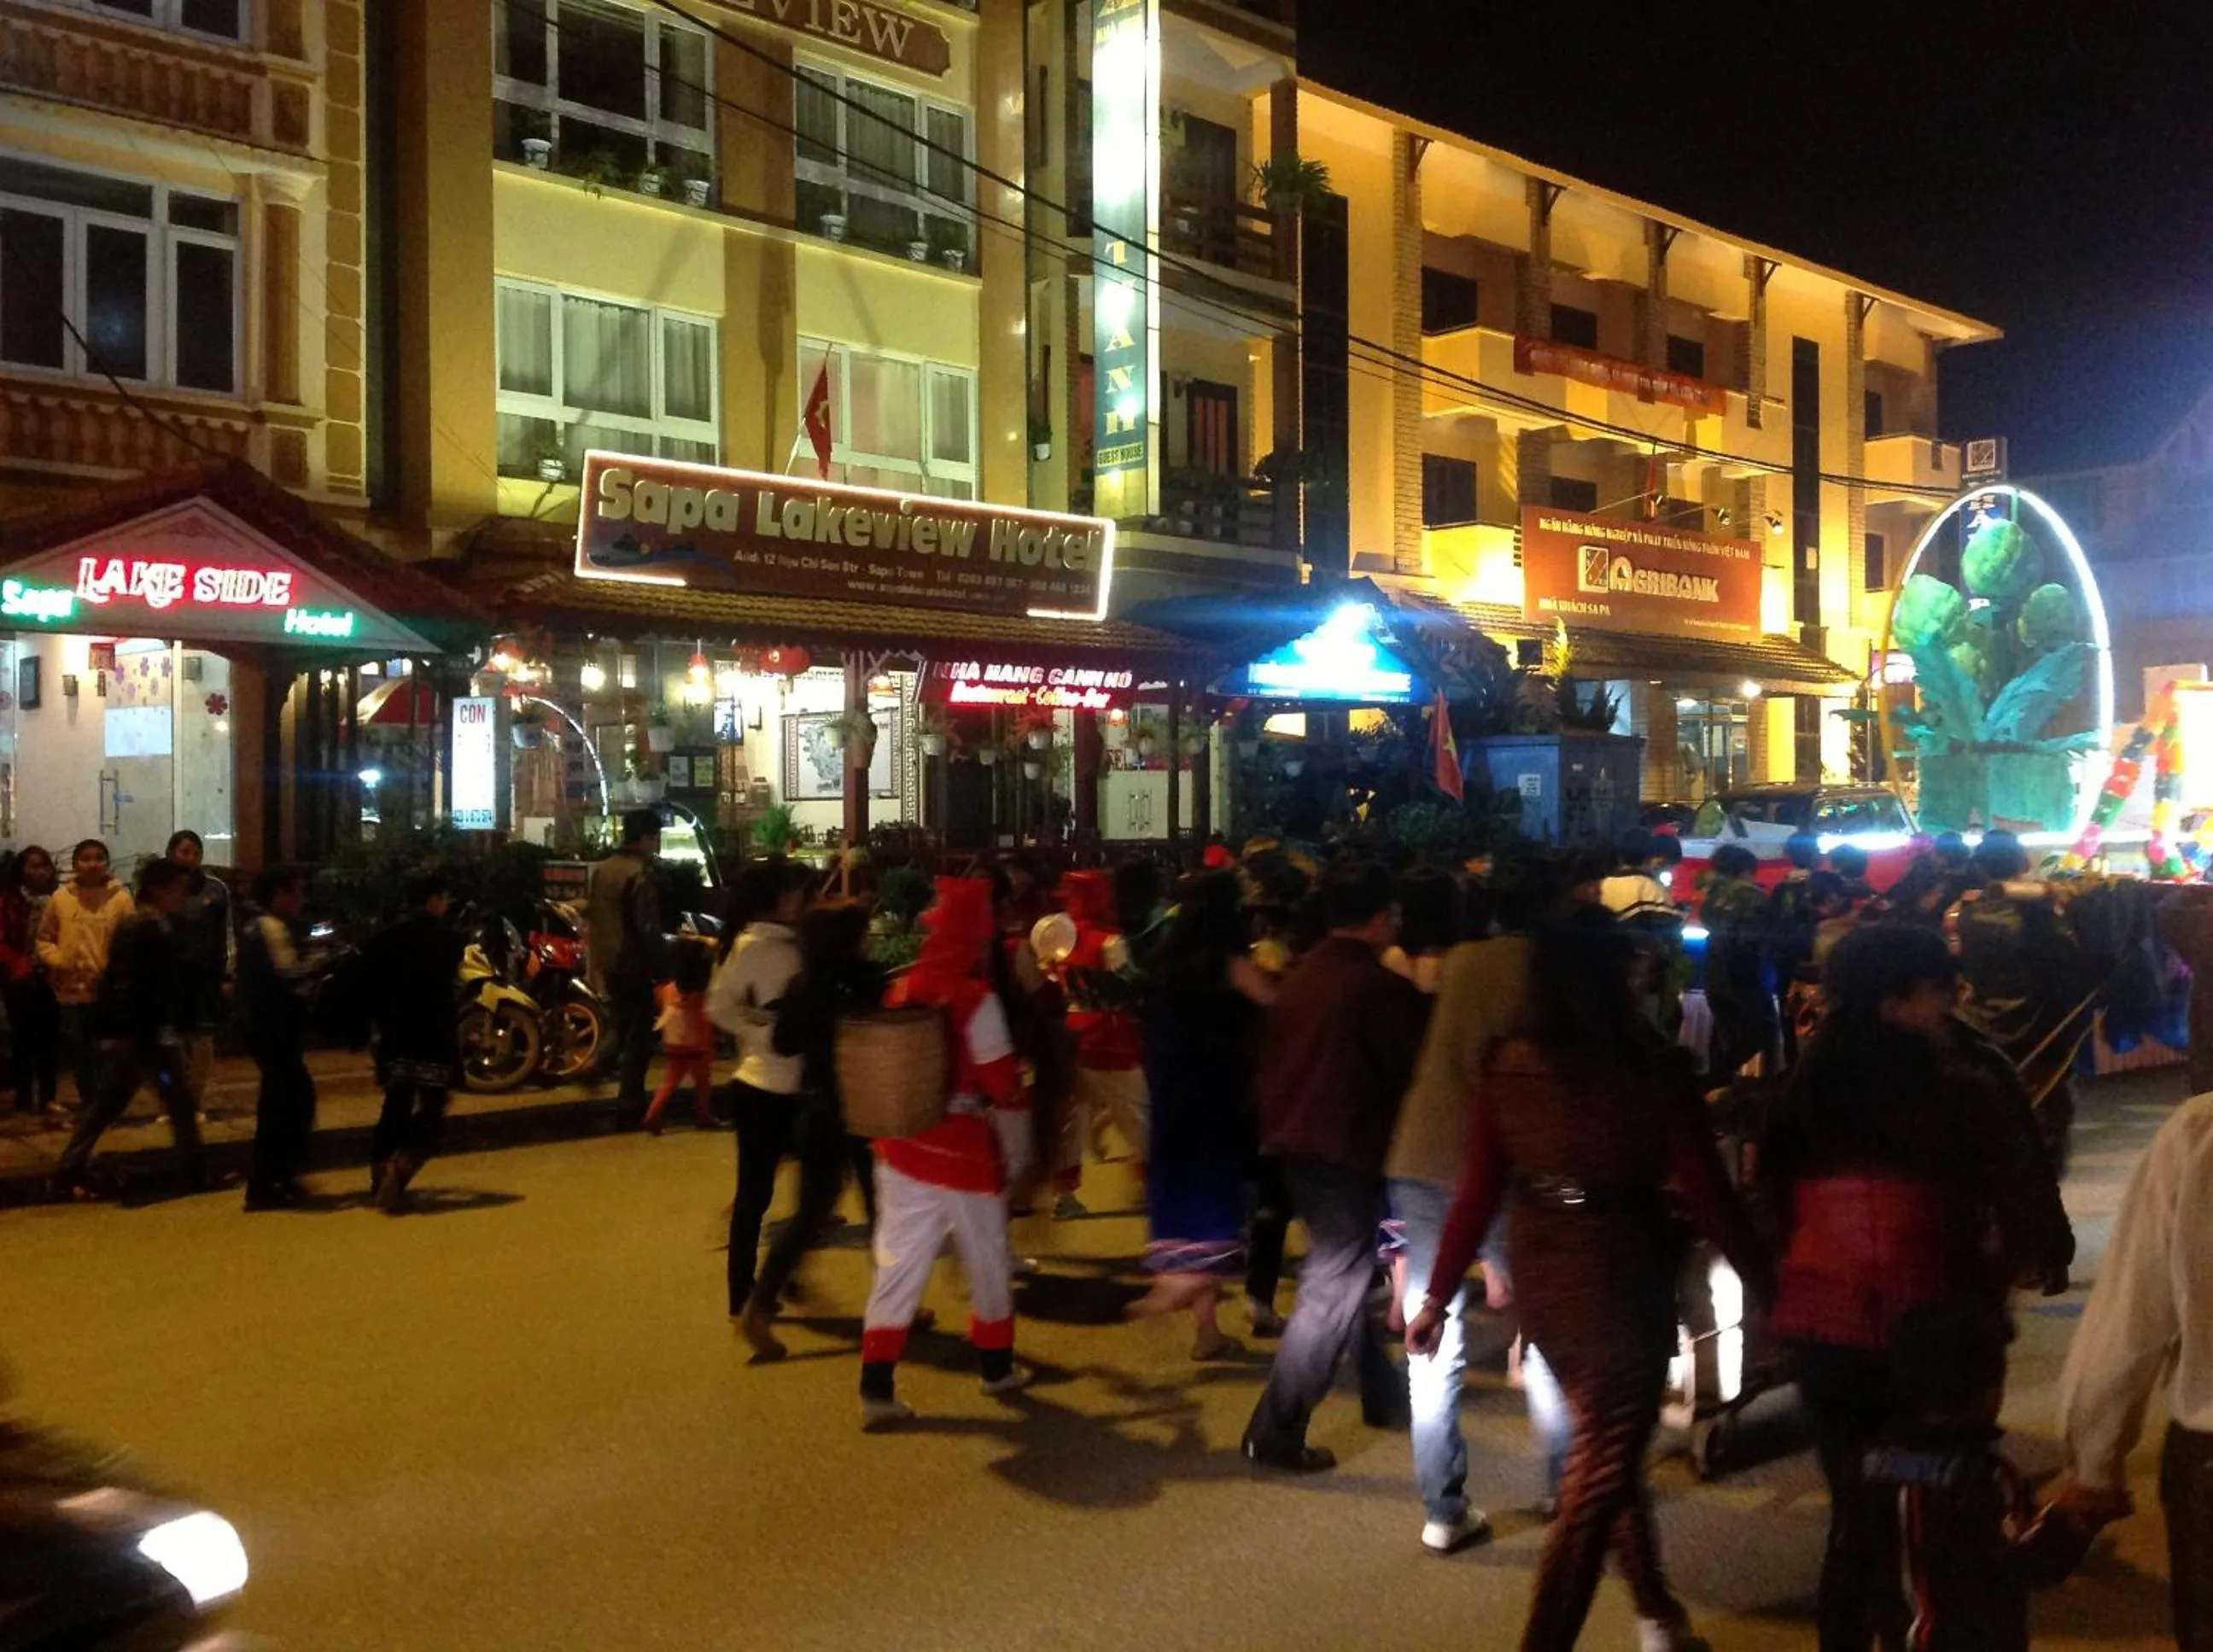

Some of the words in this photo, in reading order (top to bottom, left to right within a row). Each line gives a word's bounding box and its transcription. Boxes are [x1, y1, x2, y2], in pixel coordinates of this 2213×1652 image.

[598, 468, 740, 534] Sapa
[756, 490, 979, 558] Lakeview
[990, 517, 1103, 571] Hotel
[76, 557, 187, 609] LAKE
[193, 567, 292, 606] SIDE
[283, 608, 353, 638] Hotel
